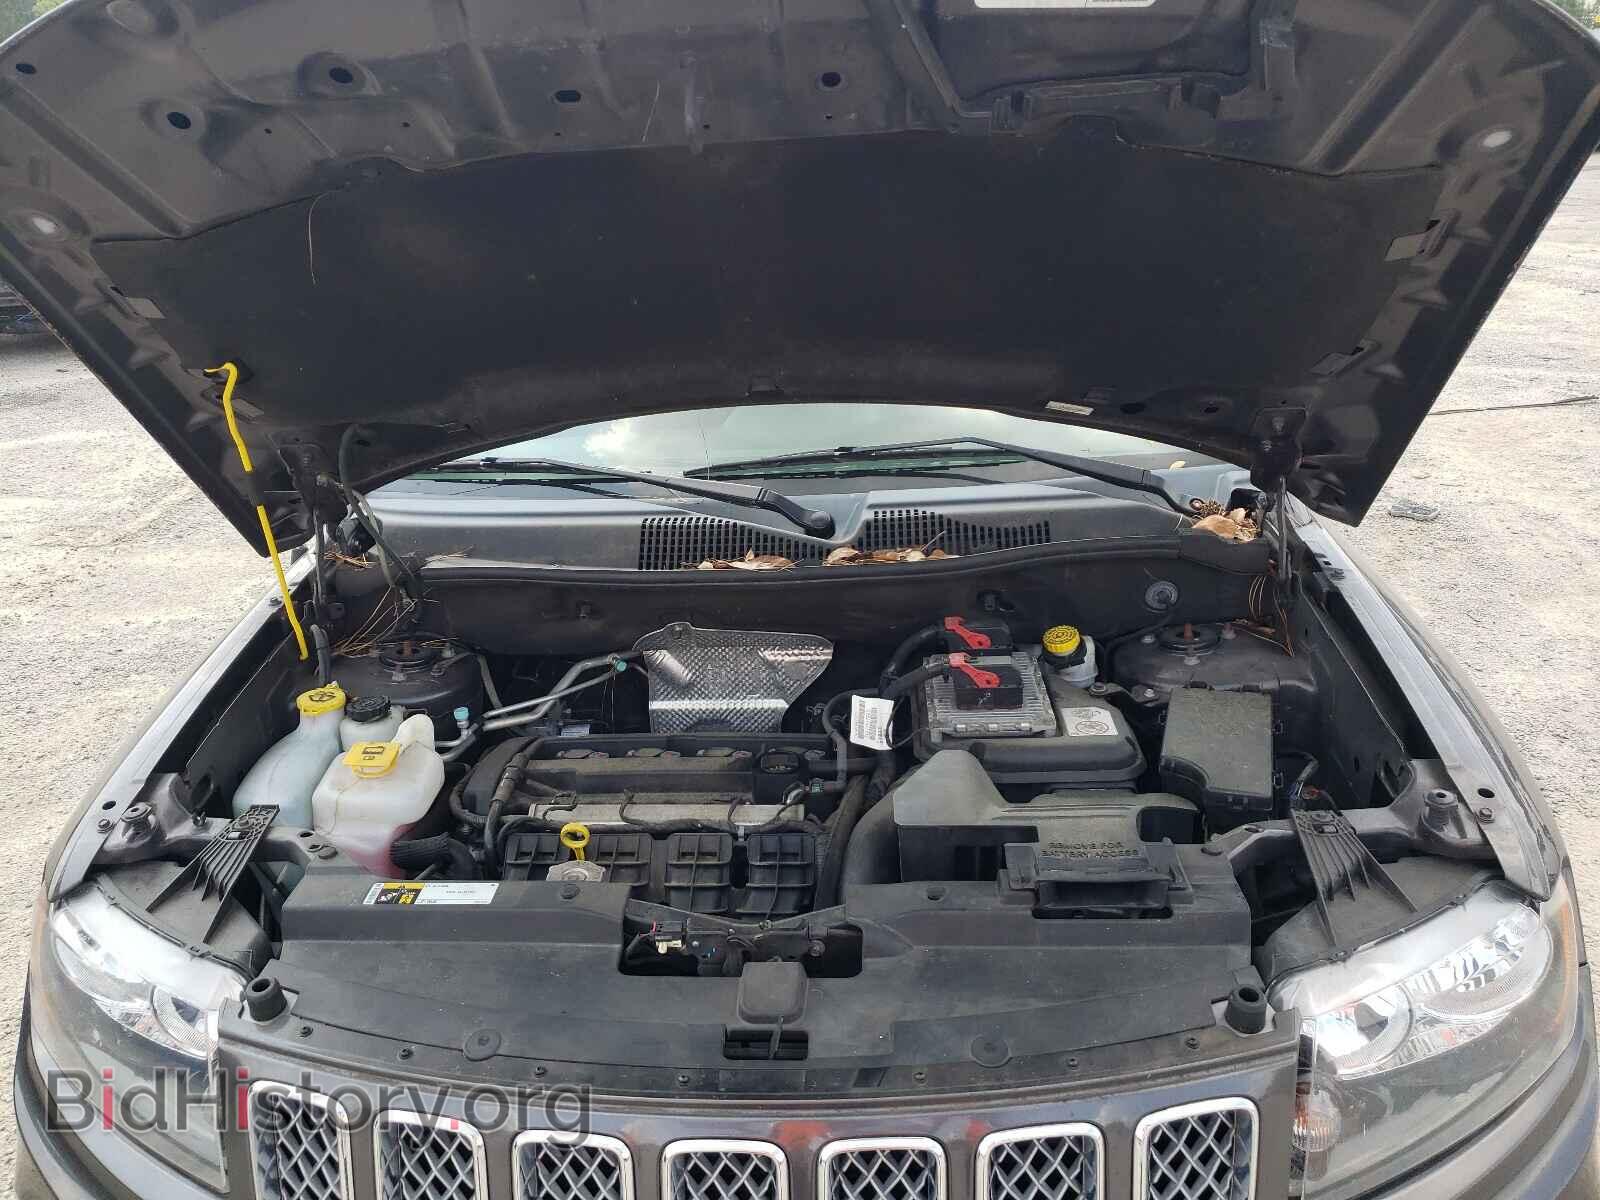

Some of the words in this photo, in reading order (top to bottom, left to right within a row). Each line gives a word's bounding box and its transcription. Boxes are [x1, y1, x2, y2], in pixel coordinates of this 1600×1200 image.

[1048, 841, 1097, 850] REMOVE
[1101, 841, 1123, 850] FOR
[1041, 849, 1089, 859] BATTERY
[1094, 849, 1138, 858] ACCESS
